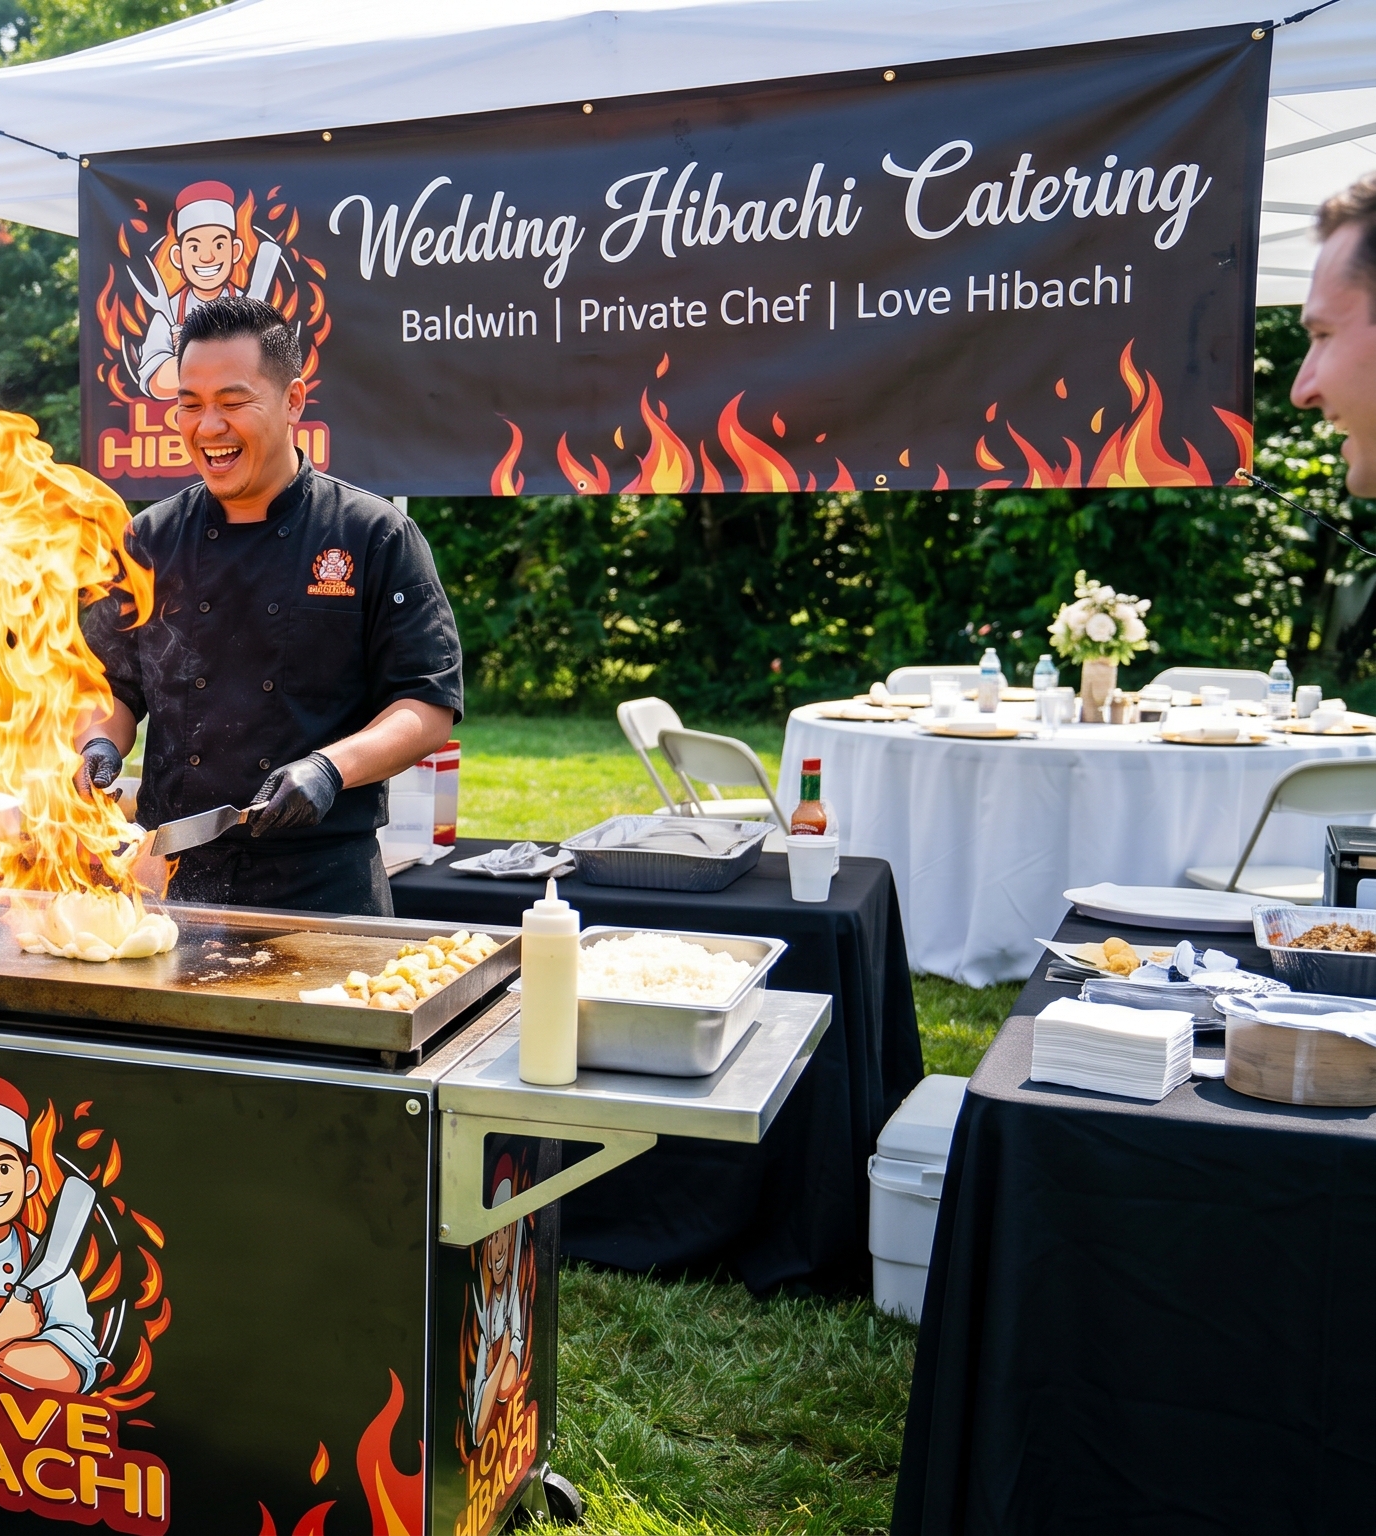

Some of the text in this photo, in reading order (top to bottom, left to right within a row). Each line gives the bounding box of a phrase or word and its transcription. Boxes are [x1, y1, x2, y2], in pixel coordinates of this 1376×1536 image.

[328, 139, 1213, 290] Wedding Hibachi Catering
[401, 303, 538, 343] Baldwin
[579, 295, 707, 333] Private
[720, 286, 812, 326] Chef
[857, 282, 952, 319] Love
[967, 264, 1133, 313] Hibachi
[103, 424, 325, 469] HIBI
[469, 1385, 525, 1500] LOVE
